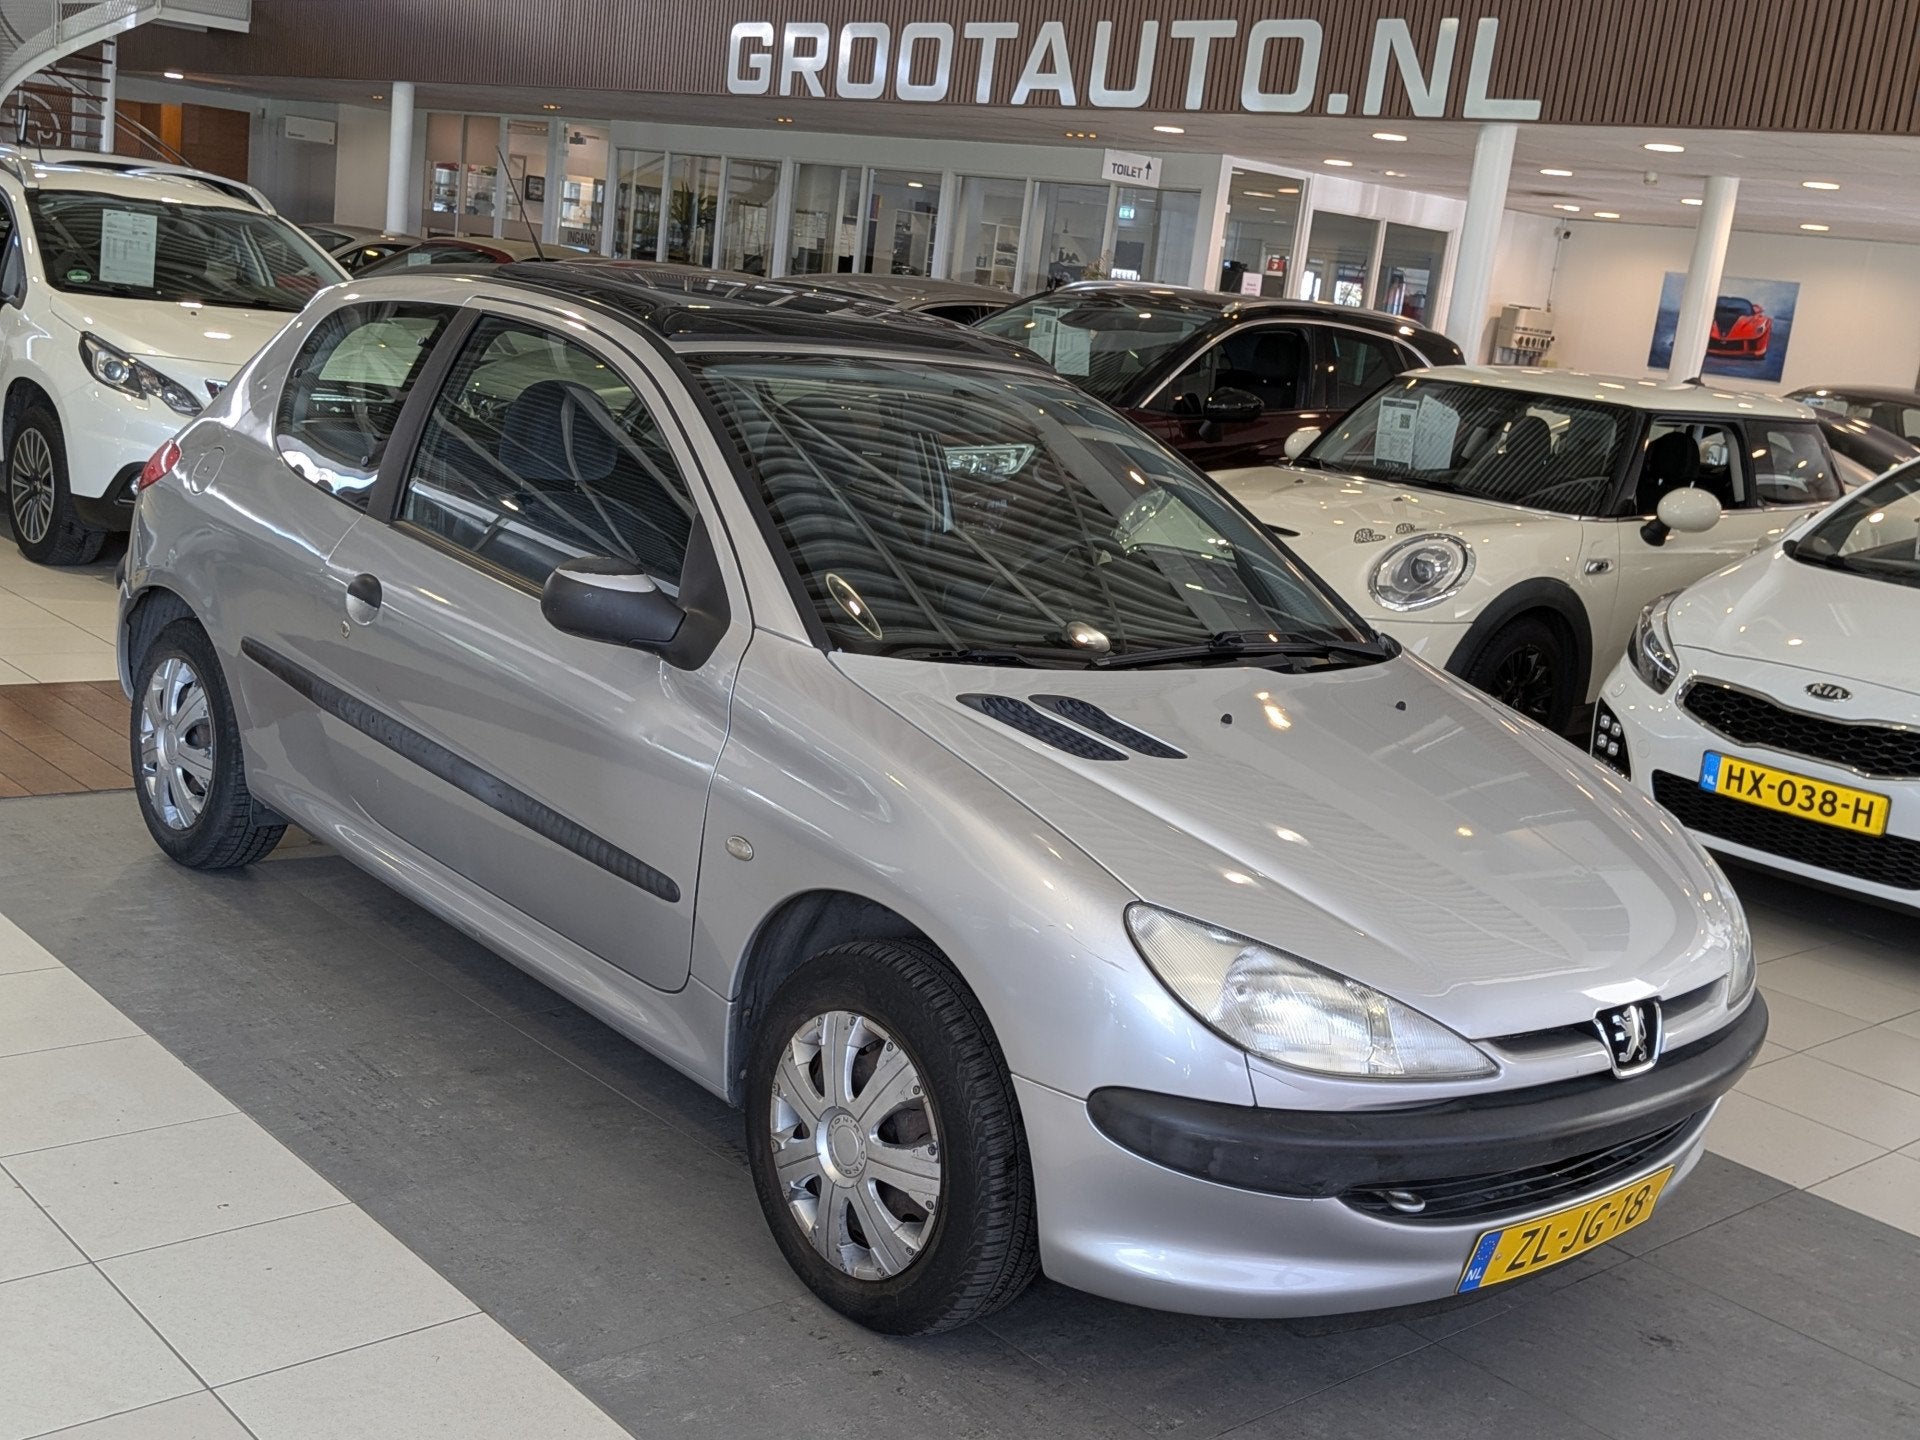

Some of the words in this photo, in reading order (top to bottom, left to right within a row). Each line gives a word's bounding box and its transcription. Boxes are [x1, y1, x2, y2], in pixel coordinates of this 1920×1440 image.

[727, 17, 1542, 121] GROOTAUTO.NL
[1112, 162, 1143, 179] TOILET
[567, 230, 596, 246] INGANG
[1810, 684, 1844, 699] KIA
[1703, 773, 1715, 786] NL
[1725, 764, 1874, 828] HX-038-H
[1504, 1184, 1651, 1273] ZL-JG-18
[1465, 1267, 1482, 1283] NL
